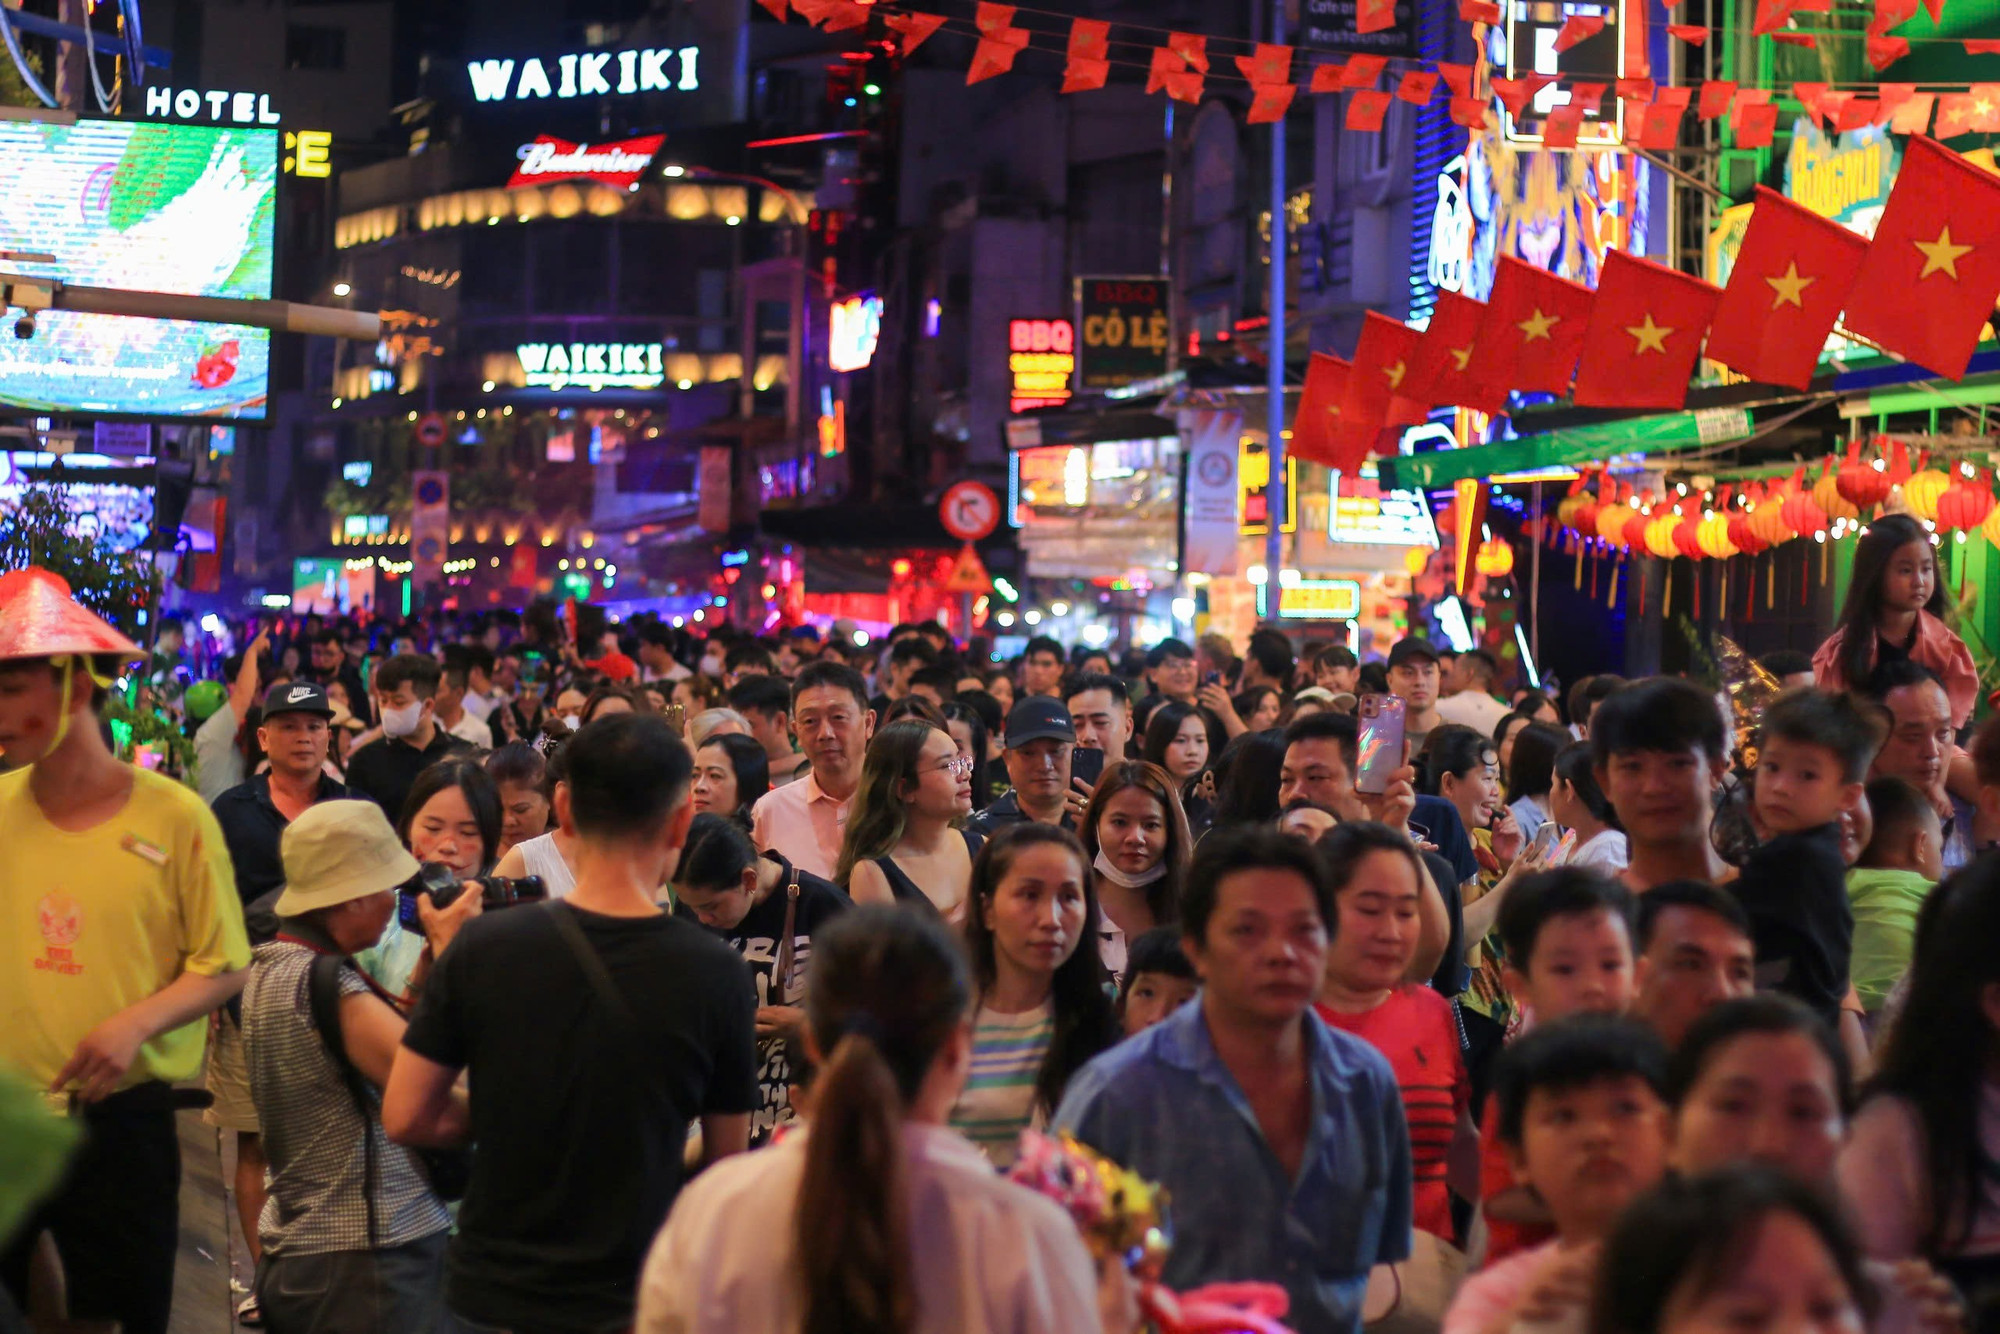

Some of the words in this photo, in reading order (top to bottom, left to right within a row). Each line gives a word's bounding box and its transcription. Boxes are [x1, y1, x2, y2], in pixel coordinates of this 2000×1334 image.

[467, 46, 700, 103] WAIKIKI
[146, 85, 281, 125] HOTEL
[516, 142, 653, 175] Budweiser
[1095, 282, 1159, 305] BBQ
[1009, 319, 1074, 353] BBQ
[517, 343, 664, 374] WAIKIKI
[291, 686, 312, 697] NIKE
